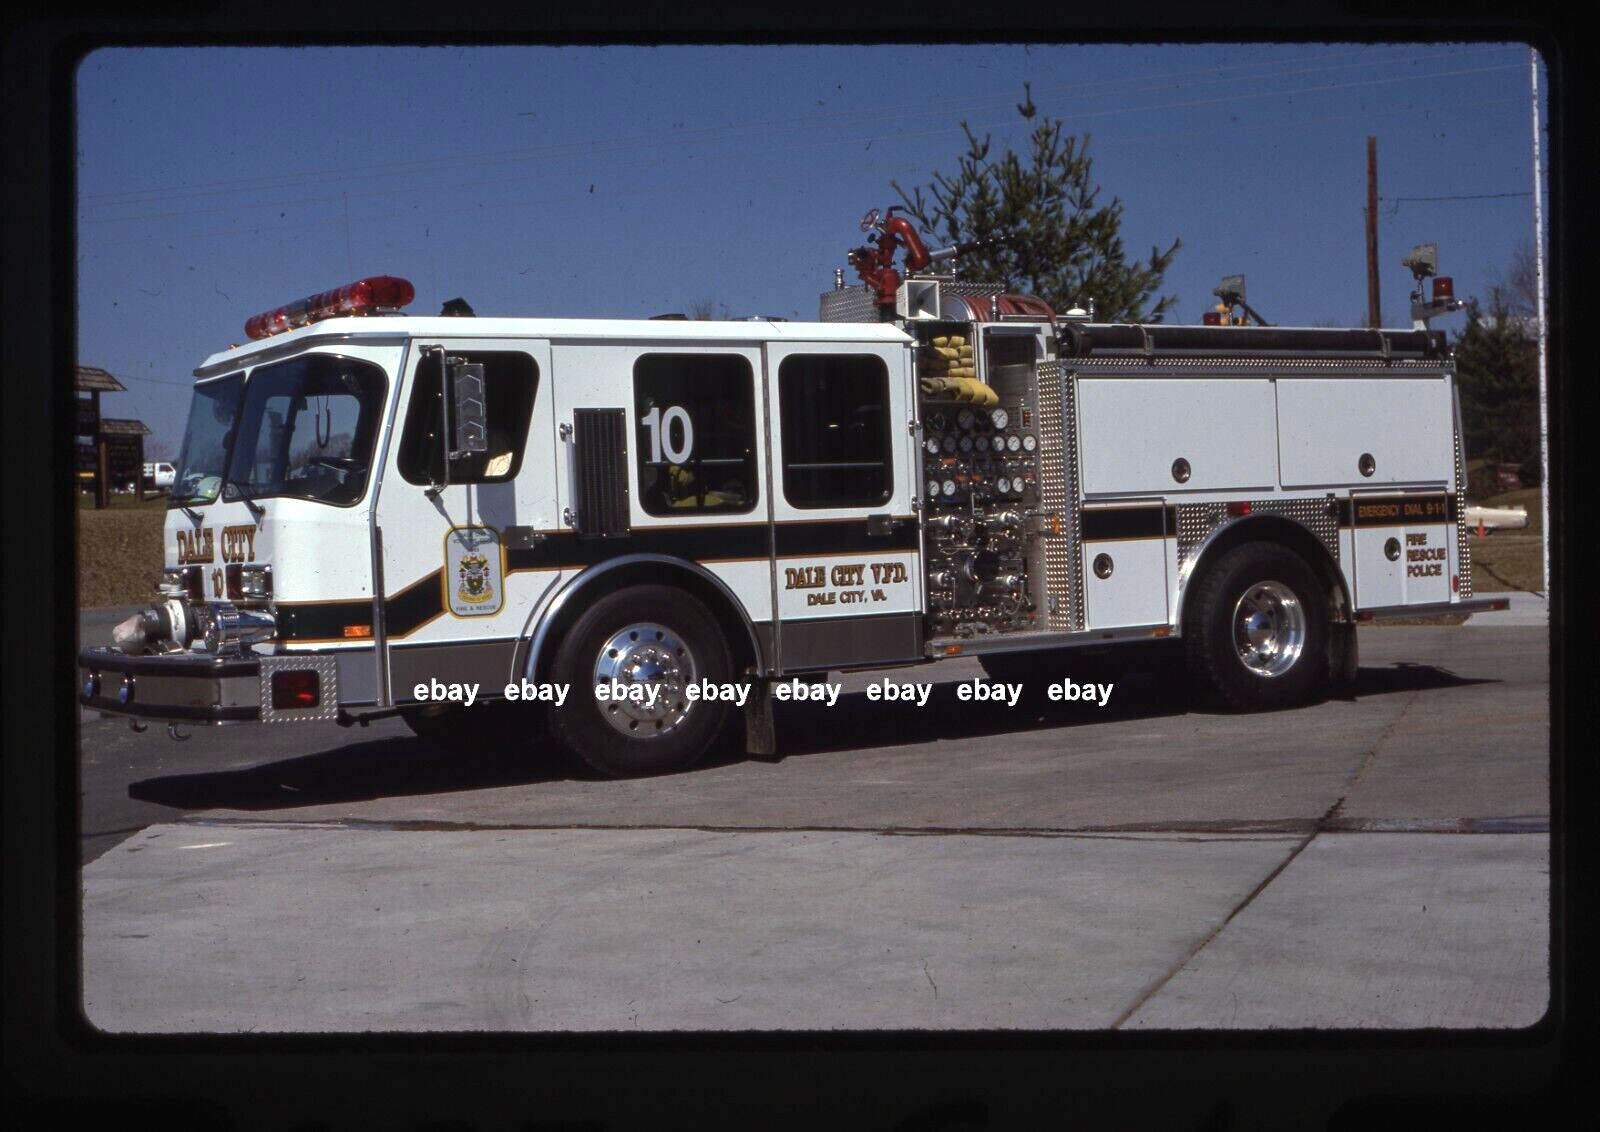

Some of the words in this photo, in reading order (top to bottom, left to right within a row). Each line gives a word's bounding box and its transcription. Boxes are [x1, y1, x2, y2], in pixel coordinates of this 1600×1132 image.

[641, 405, 694, 464] 10
[1358, 504, 1400, 518] EMERGENCY
[1403, 503, 1424, 516] DIAL
[176, 527, 214, 565] DALE
[221, 524, 257, 563] CITY
[1406, 533, 1427, 546] FIRE
[1407, 548, 1446, 562] RESCUE
[785, 566, 826, 590] DALE
[830, 564, 865, 586] CITY
[1407, 564, 1442, 577] POLICE
[212, 567, 224, 598] 10
[807, 592, 836, 606] DALE
[839, 590, 868, 604] CITY,
